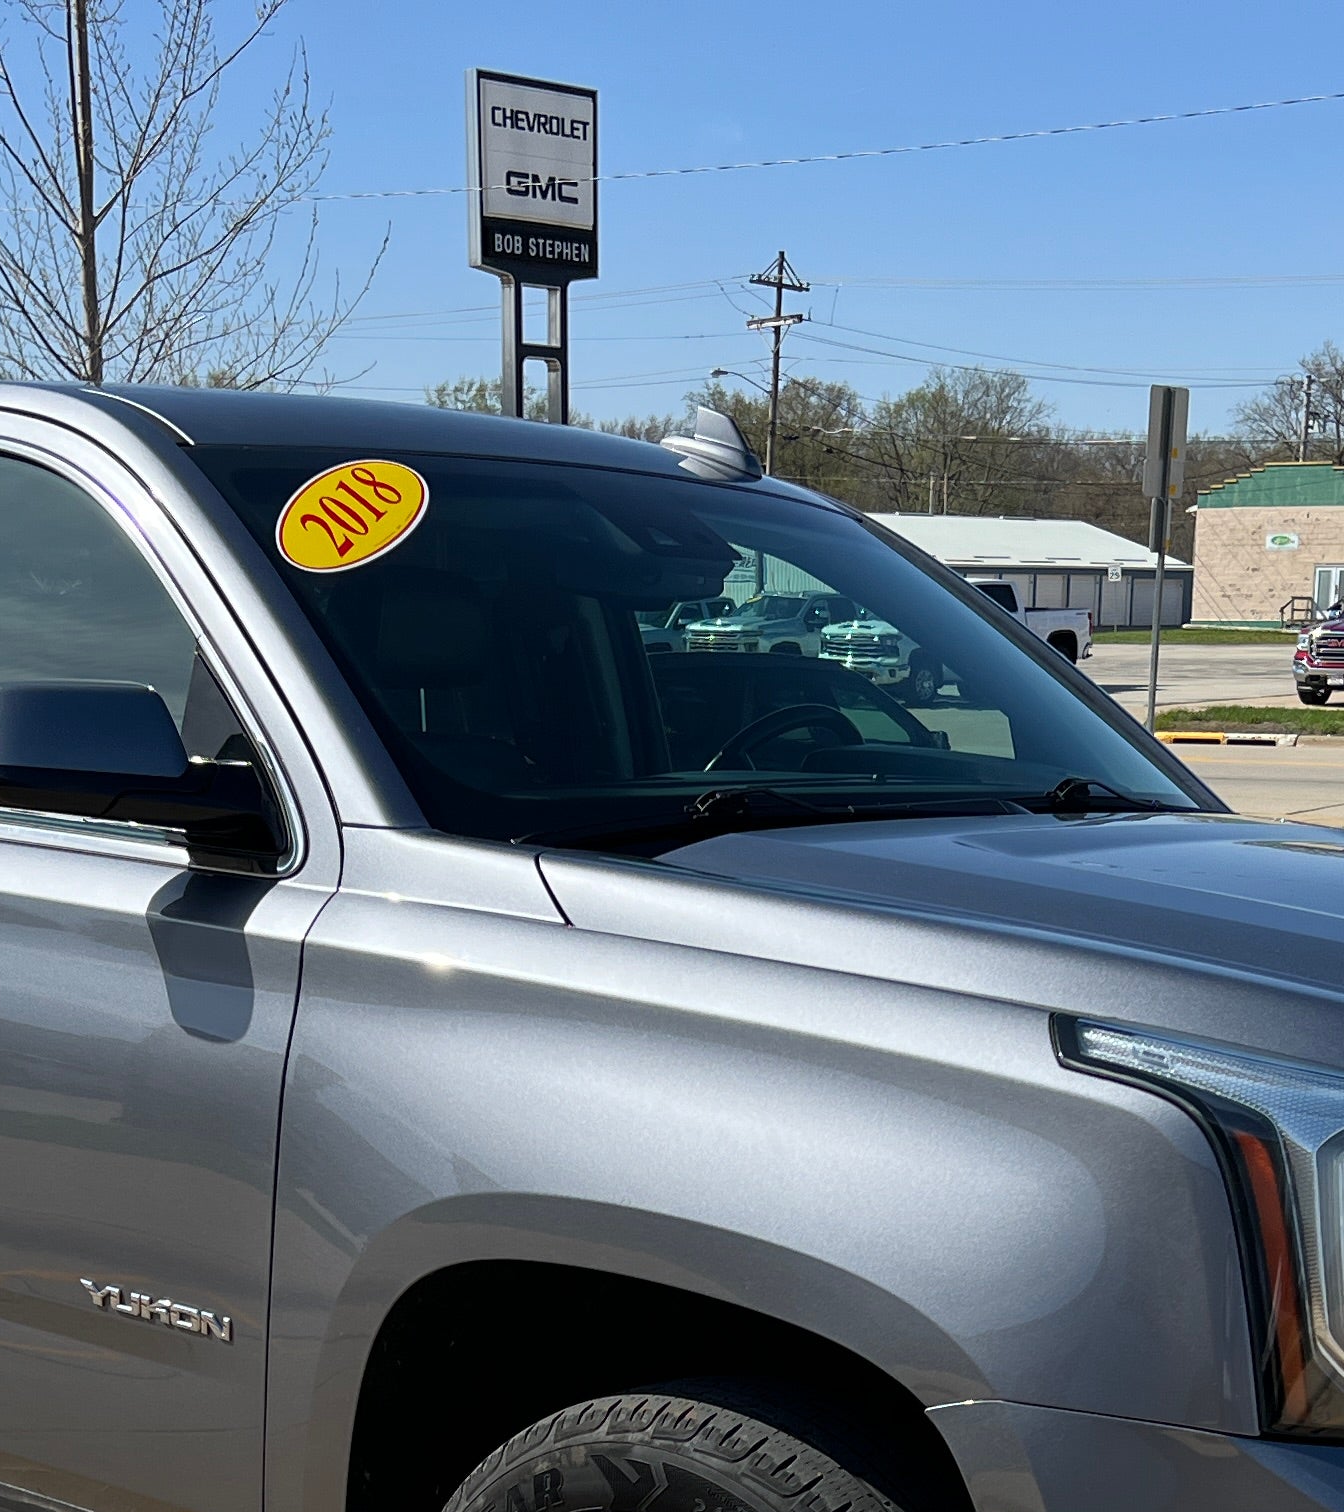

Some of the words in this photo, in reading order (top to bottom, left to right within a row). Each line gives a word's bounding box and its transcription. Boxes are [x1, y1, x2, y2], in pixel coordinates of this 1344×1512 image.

[491, 106, 590, 141] CHEVROLET
[506, 170, 579, 205] GMC
[494, 233, 523, 255] BOB
[528, 237, 590, 263] STEPHEN
[300, 467, 402, 558] 2018
[80, 1278, 233, 1342] YUKON
